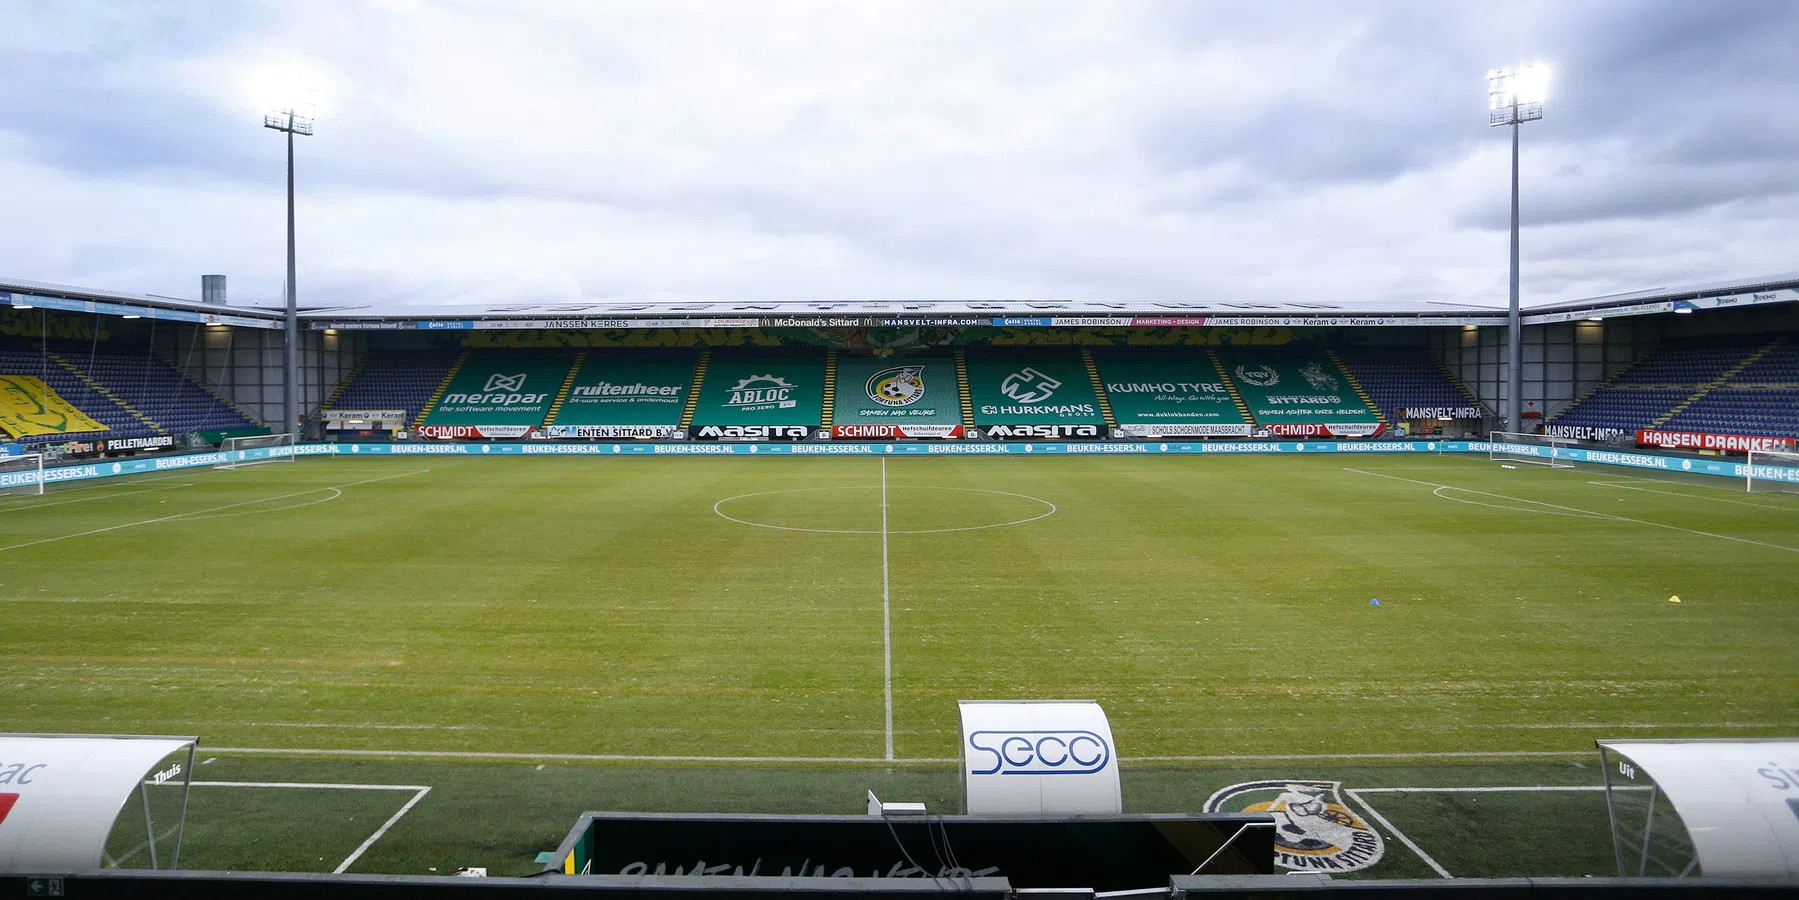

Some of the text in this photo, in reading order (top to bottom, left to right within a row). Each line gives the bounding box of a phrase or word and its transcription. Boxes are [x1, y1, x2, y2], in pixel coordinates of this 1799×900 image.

[774, 318, 859, 326] McDonald's Sittard
[573, 381, 682, 395] ruitenheer
[1107, 383, 1226, 392] KUMHO TYRE
[443, 393, 548, 405] merapar
[728, 388, 789, 404] ABLOC
[872, 394, 903, 405] FORTUNA
[1001, 404, 1094, 414] HURKMANS
[1406, 408, 1481, 419] MANSVELT-INFRA
[418, 426, 473, 437] SCHMIDT
[612, 428, 652, 437] SITTARD
[837, 426, 897, 437] SCHMIDT
[1152, 426, 1172, 434] SCHOLS
[1173, 426, 1209, 434] SCHOENMODE
[1210, 426, 1245, 434] MAASBRACHT
[1266, 424, 1322, 435] SCHMIDT
[108, 437, 172, 450] PELLETHAARDEN
[1644, 432, 1700, 446] HANSEN
[391, 444, 467, 453] BEUKEN-ESSERS.NL
[522, 444, 600, 453] BEUKEN-ESSERS.NL
[654, 444, 734, 453] BEUKEN-ESSERS.NL
[792, 444, 872, 453] BEUKEN-ESSERS.NL
[928, 444, 1009, 453] BEUKEN-ESSERS.NL
[1067, 444, 1147, 452] BEUKEN-ESSERS.NL
[1202, 443, 1281, 452] BEUKEN-ESSERS.NL
[1337, 443, 1415, 451] BEUKEN-ESSERS.NL
[1468, 443, 1539, 455] BEUKEN-ESSERS.NL
[156, 455, 227, 469] BEUKEN-ESSERS.NL
[1587, 452, 1667, 467] BEUKEN-ESSERS.NL
[0, 466, 98, 486] EUKEN-ESSERS.NL
[153, 763, 181, 786] Thuis
[1619, 761, 1635, 780] Uit
[1340, 831, 1377, 866] SITTARD
